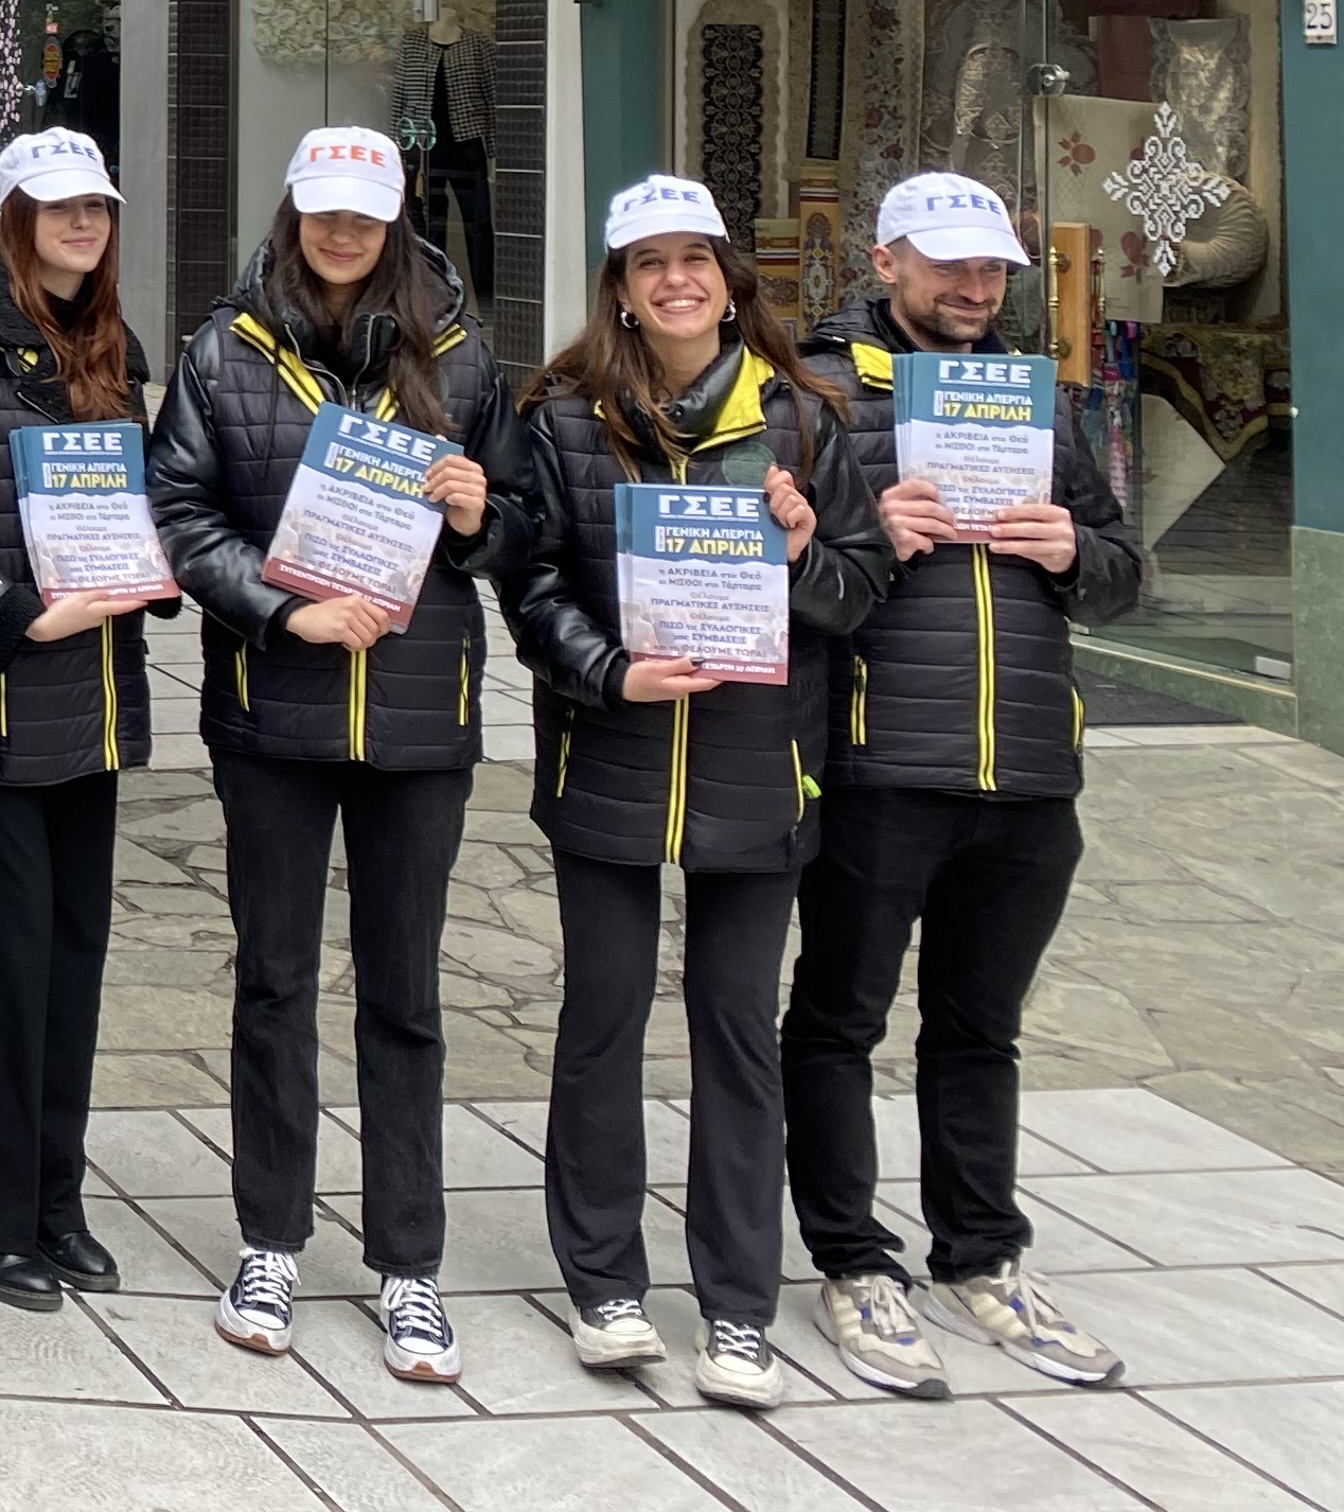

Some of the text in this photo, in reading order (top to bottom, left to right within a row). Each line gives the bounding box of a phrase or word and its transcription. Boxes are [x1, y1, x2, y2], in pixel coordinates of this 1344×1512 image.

[1307, 3, 1332, 29] 25
[32, 141, 97, 161] ΓΣΕΕ
[309, 145, 386, 168] ΓΣΕΕ
[623, 187, 700, 212] ΓΣΕΕ
[926, 194, 1002, 215] ΓΣΕΕ
[940, 360, 1032, 384] ΓΣΕΕ
[945, 391, 1033, 406] ΓΕΝΙΚΗ ΑΠΕΡΓΙΑ
[944, 403, 1031, 422] 17 ΑΠΡΙΛΗ
[42, 432, 123, 451] ΓΣΕΕ
[338, 414, 437, 462] ΓΣΕΕ
[337, 445, 382, 467] ΓΕΝΙΚΗ
[51, 463, 127, 472] ΓΕΝΙΚΗ ΑΠΕΡΓΙΑ
[334, 456, 426, 499] 17 ΑΠΡΙΛΗ
[52, 474, 127, 488] 17 ΑΠΡΙΛΗ
[658, 495, 759, 517] ΓΣΕΕ
[666, 526, 763, 540] ΓΕΝΙΚΗ ΑΠΕΡΓΙΑ
[666, 538, 762, 557] 17 ΑΠΡΙΛΗ
[668, 568, 717, 578] ΑΚΡΙΒΕΙΑ
